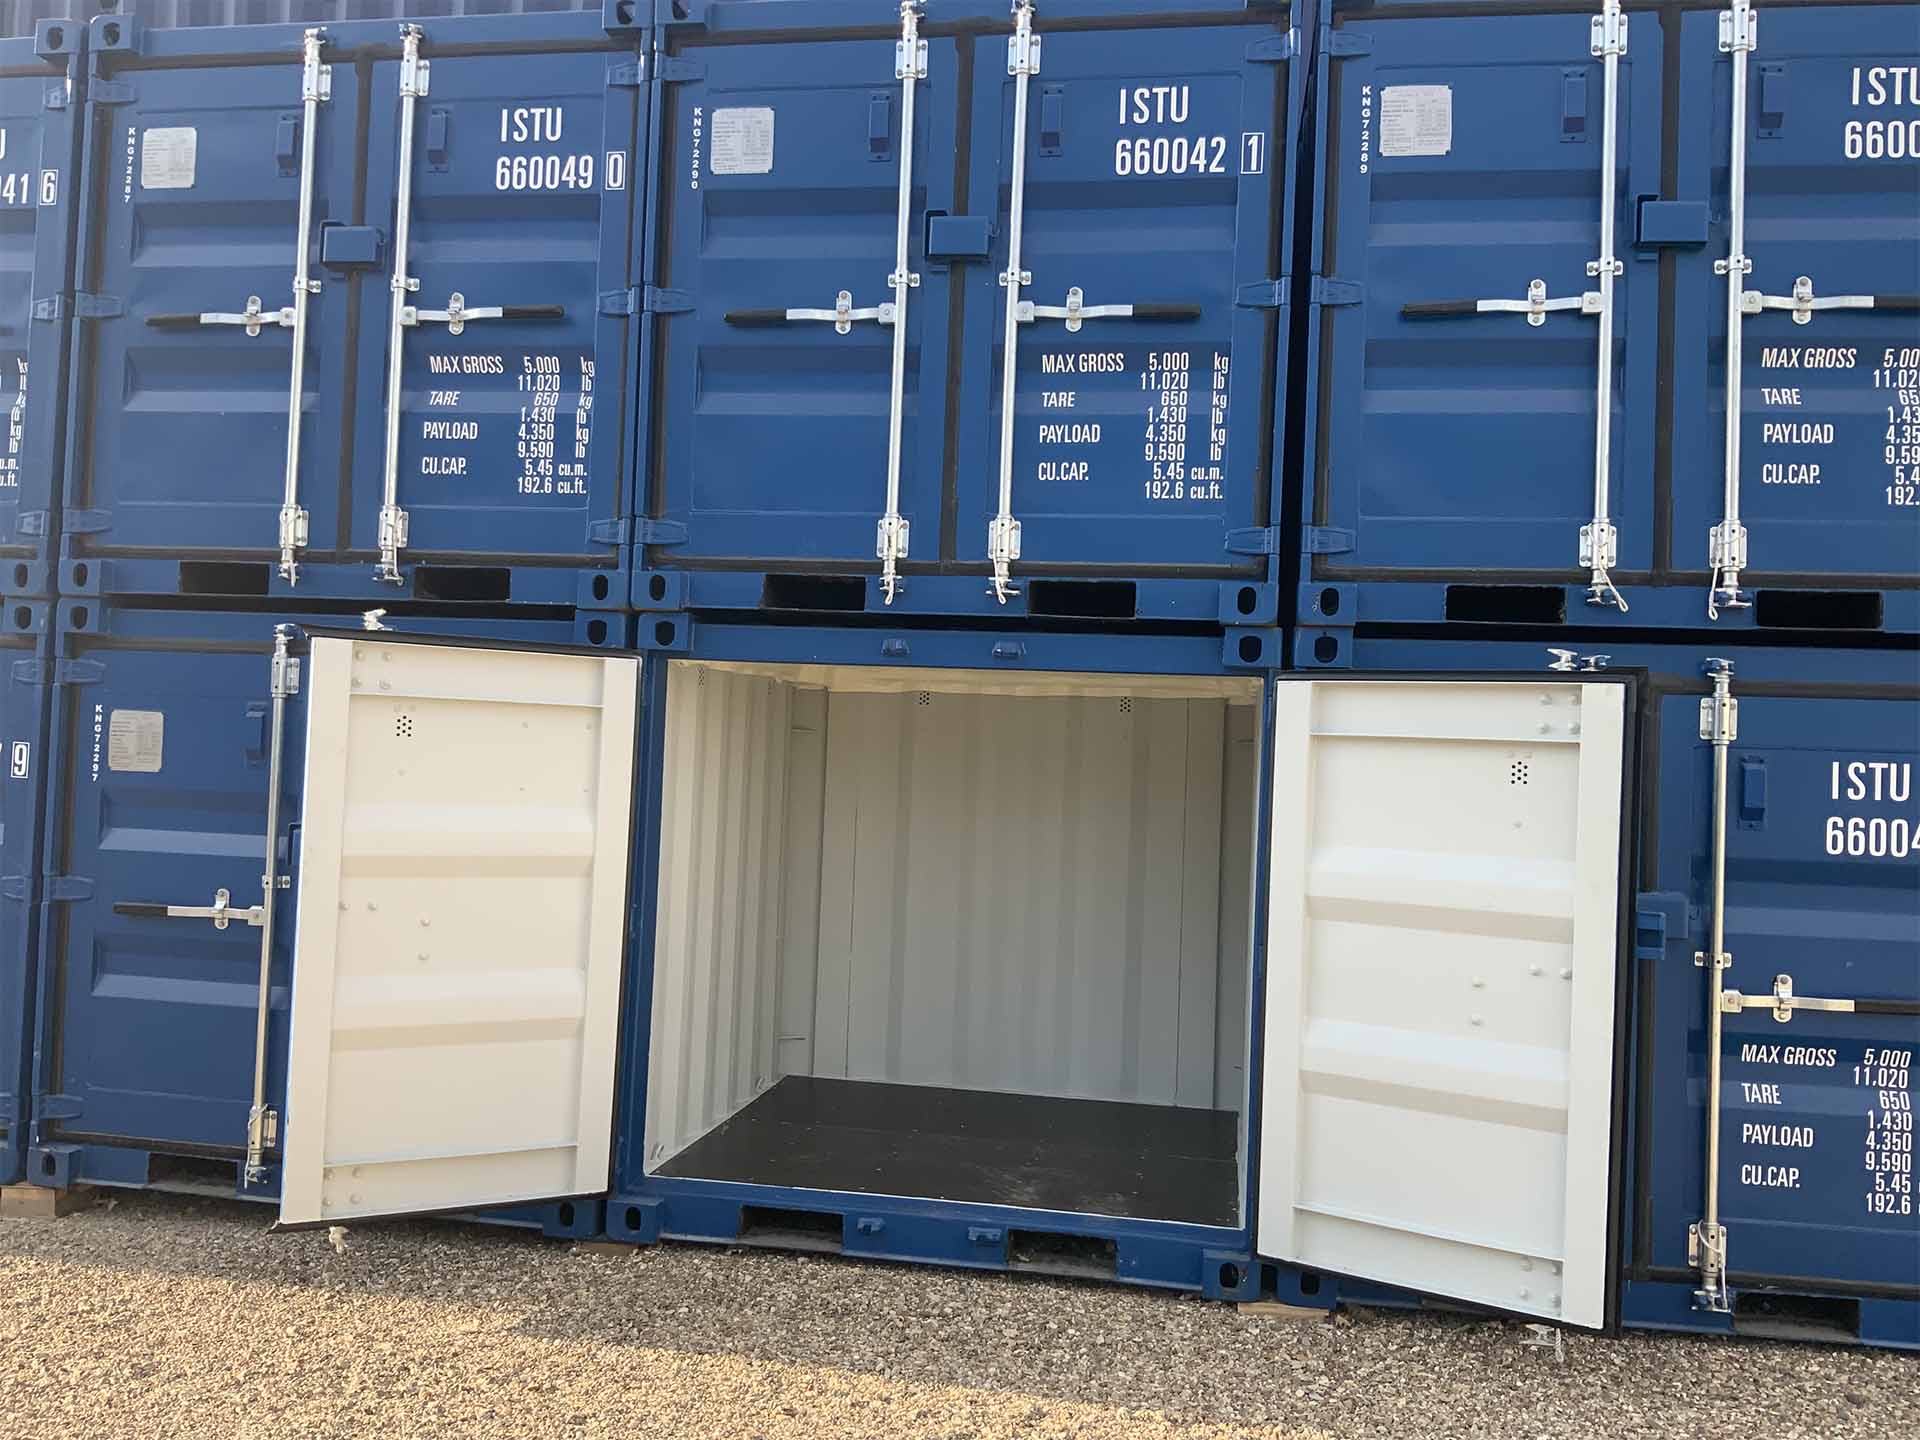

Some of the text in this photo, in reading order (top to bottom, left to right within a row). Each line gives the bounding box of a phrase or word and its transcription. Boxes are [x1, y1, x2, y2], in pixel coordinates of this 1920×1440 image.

[1120, 86, 1188, 124] ISTU
[501, 108, 561, 141] ISTU
[1116, 137, 1225, 175] 660042
[496, 154, 623, 189] 660049 0
[41, 172, 56, 202] 6
[430, 356, 460, 373] MAX
[463, 356, 503, 373] GROSS
[580, 357, 595, 377] kg
[1043, 354, 1075, 373] MAX
[1079, 353, 1123, 372] GROSS
[1214, 352, 1228, 372] kg
[1762, 348, 1801, 367] MAX
[1804, 348, 1856, 368] GROSS
[581, 375, 593, 391] lb
[1213, 372, 1227, 389] lb
[1874, 369, 1920, 388] 11,02
[429, 392, 593, 409] TARE 650 kg
[1042, 391, 1227, 409] TARE 650 kg
[1761, 389, 1801, 404] TARE
[576, 408, 588, 424] lb
[1211, 408, 1223, 425] lb
[424, 422, 477, 439] PAYLOAD
[575, 423, 589, 443] kg
[1040, 425, 1100, 443] PAYLOAD
[1211, 424, 1225, 445] kg
[1764, 424, 1833, 443] PAYLOAD
[575, 441, 587, 457] lb
[1210, 443, 1223, 460] lb
[422, 457, 588, 475] CU.CAP. 5.45 cu.m.
[1039, 462, 1224, 480] CU.CAP. 5.45 cu.m.
[1763, 464, 1820, 483] CU.CAP.
[518, 477, 586, 493] 192.6 cu.ft.
[1145, 481, 1222, 499] 192.6 cu.ft.
[13, 745, 28, 776] 9
[1832, 762, 1910, 801] ISTU
[1742, 1044, 1780, 1063] MAX
[1784, 1047, 1836, 1066] GROSS
[1741, 1083, 1910, 1110] TARE 650
[1743, 1124, 1813, 1147] PAYLOAD
[1742, 1165, 1910, 1194] CU.CAP. 5.45
[1867, 1193, 1911, 1214] 192.6
